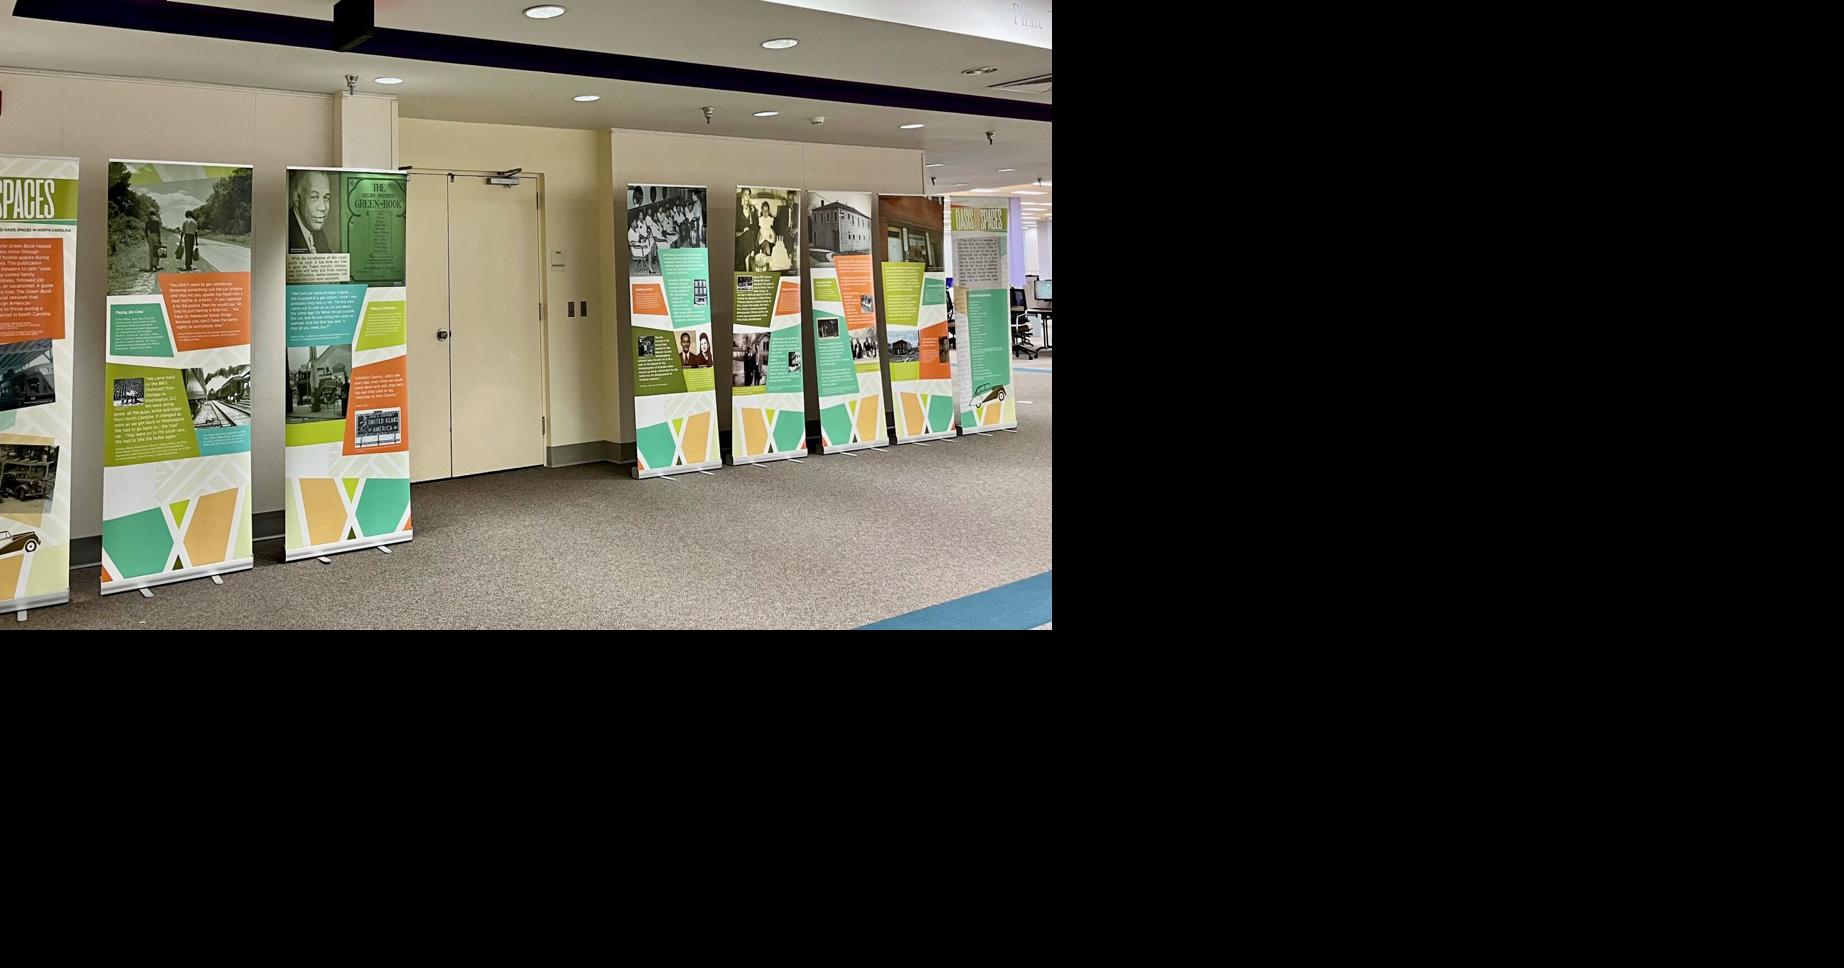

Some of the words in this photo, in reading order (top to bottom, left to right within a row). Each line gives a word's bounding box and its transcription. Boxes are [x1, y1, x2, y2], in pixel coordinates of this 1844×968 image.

[372, 183, 386, 193] THE
[0, 179, 54, 219] PACES
[355, 200, 402, 209] GREEN-BOOK
[956, 208, 974, 230] OASIS
[980, 208, 1003, 230] SPACES
